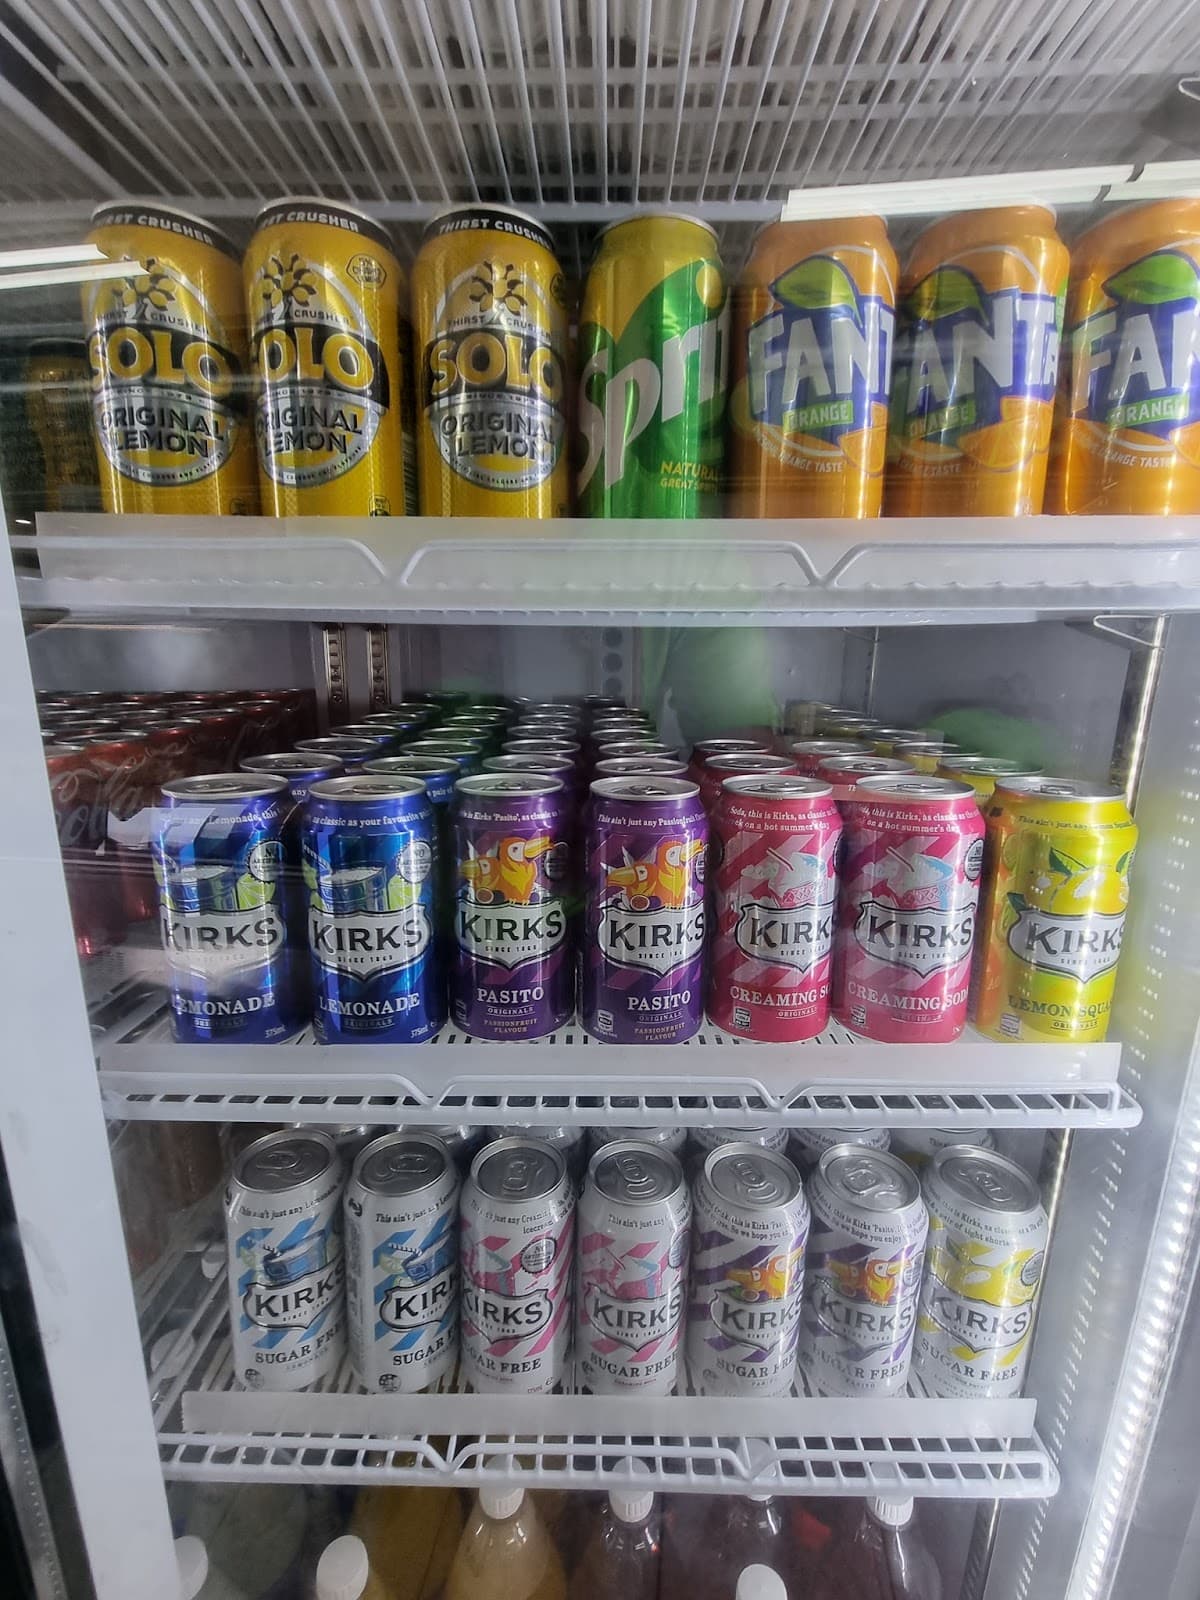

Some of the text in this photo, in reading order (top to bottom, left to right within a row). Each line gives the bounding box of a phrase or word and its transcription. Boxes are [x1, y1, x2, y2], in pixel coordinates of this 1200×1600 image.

[138, 215, 213, 245] CRUSHER
[287, 211, 359, 232] CRUSHER
[439, 218, 490, 234] THIRST
[89, 326, 233, 398] SOLO
[258, 327, 375, 391] OLO
[430, 332, 563, 404] SOLO
[101, 405, 224, 442] ORIGINAL
[787, 402, 849, 429] ORANGE
[116, 429, 209, 459] LEMON
[265, 430, 348, 457] LEMON
[347, 818, 358, 827] as
[360, 818, 381, 829] your
[627, 817, 642, 828] just
[643, 820, 657, 829] any
[748, 809, 762, 819] this
[764, 810, 771, 819] is
[885, 821, 899, 830] hot
[764, 822, 778, 830] hot
[163, 917, 278, 953] KIRKS
[312, 918, 422, 955] KIRKS
[460, 910, 562, 943] KIRKS
[609, 912, 704, 951] KIRKS
[868, 915, 972, 949] KIRKS
[319, 992, 421, 1017] LEMONADE
[477, 986, 545, 1005] PASITO
[627, 990, 692, 1012] PASITO
[730, 985, 817, 1007] CREAMING
[848, 981, 941, 1011] CREAMING
[1008, 994, 1072, 1017] LEMON
[487, 1006, 535, 1016] ORIGINALS
[483, 1017, 538, 1029] PASSIONFRUIT
[494, 1025, 528, 1034] FLAVOUR
[634, 1022, 686, 1035] PASSIONFRUIT
[645, 1031, 677, 1042] FLAVOUR
[288, 1205, 303, 1215] any
[375, 1212, 392, 1223] This
[593, 1293, 681, 1328] KIRKS
[819, 1291, 912, 1333] KIRKS
[929, 1287, 1028, 1335] KIRKS
[255, 1343, 312, 1365] SUGAR
[392, 1337, 444, 1366] SUGAR
[920, 1337, 975, 1378] SUGAR
[500, 1358, 542, 1374] FREE
[590, 1351, 640, 1378] SUGAR
[716, 1357, 769, 1379] SUGAR
[870, 1361, 905, 1380] FREE
